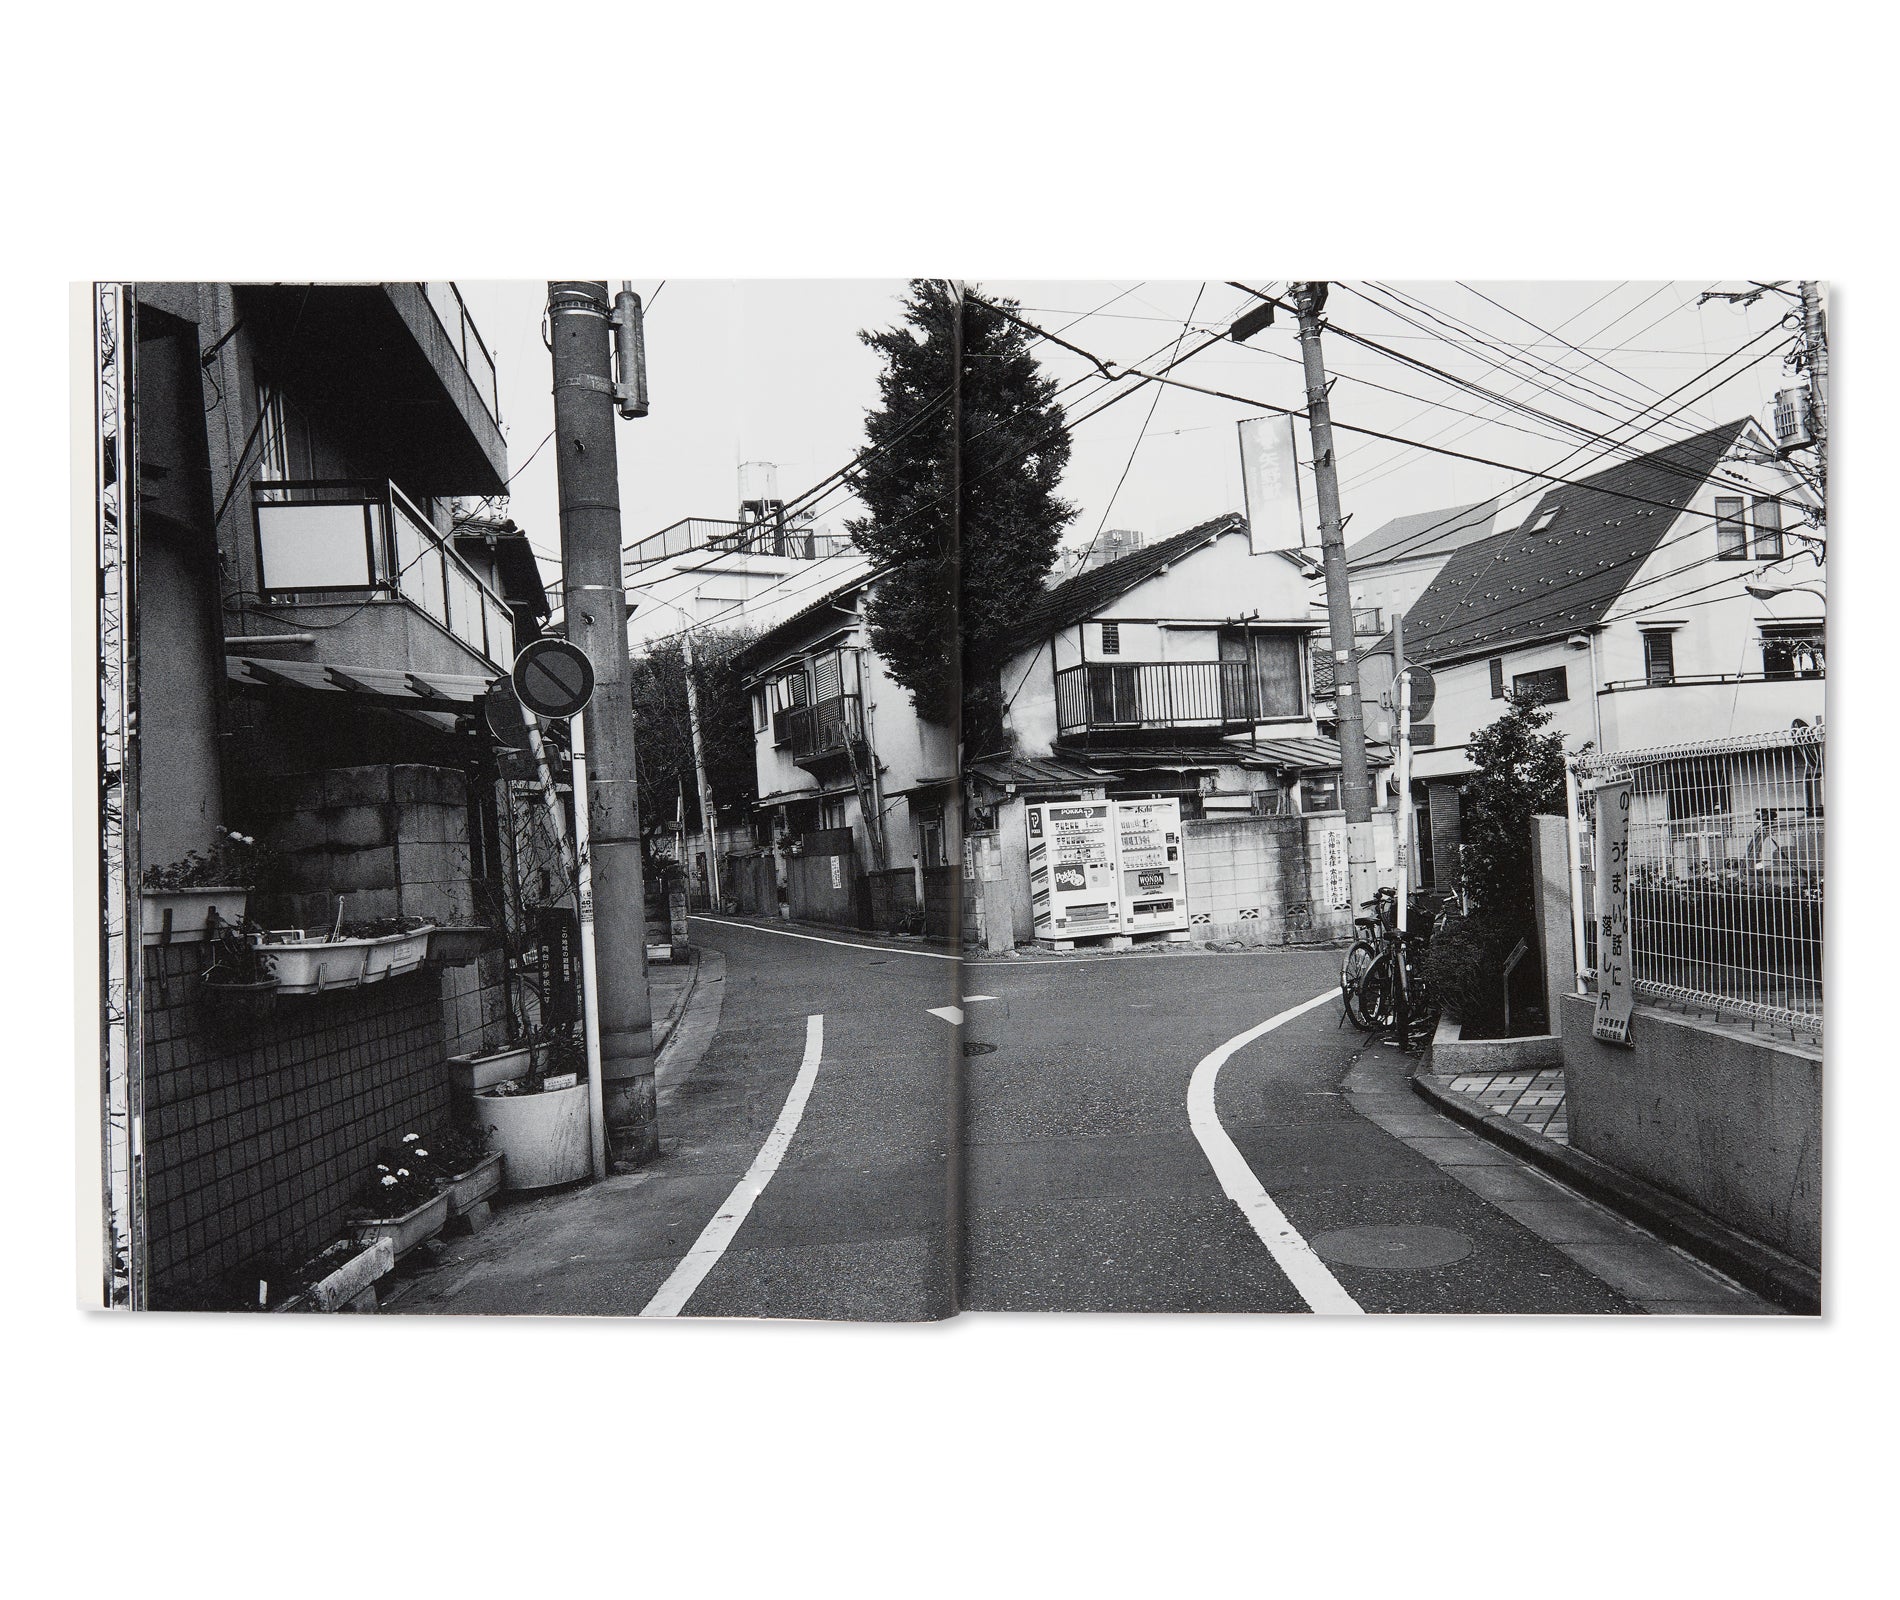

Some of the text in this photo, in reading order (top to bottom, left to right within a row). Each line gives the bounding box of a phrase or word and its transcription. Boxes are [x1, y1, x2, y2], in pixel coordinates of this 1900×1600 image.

[1055, 869, 1077, 884] Pokka
[1139, 875, 1163, 884] WONDA
[1611, 841, 1623, 986] うまい話に
[1599, 914, 1612, 1011] 落し穴
